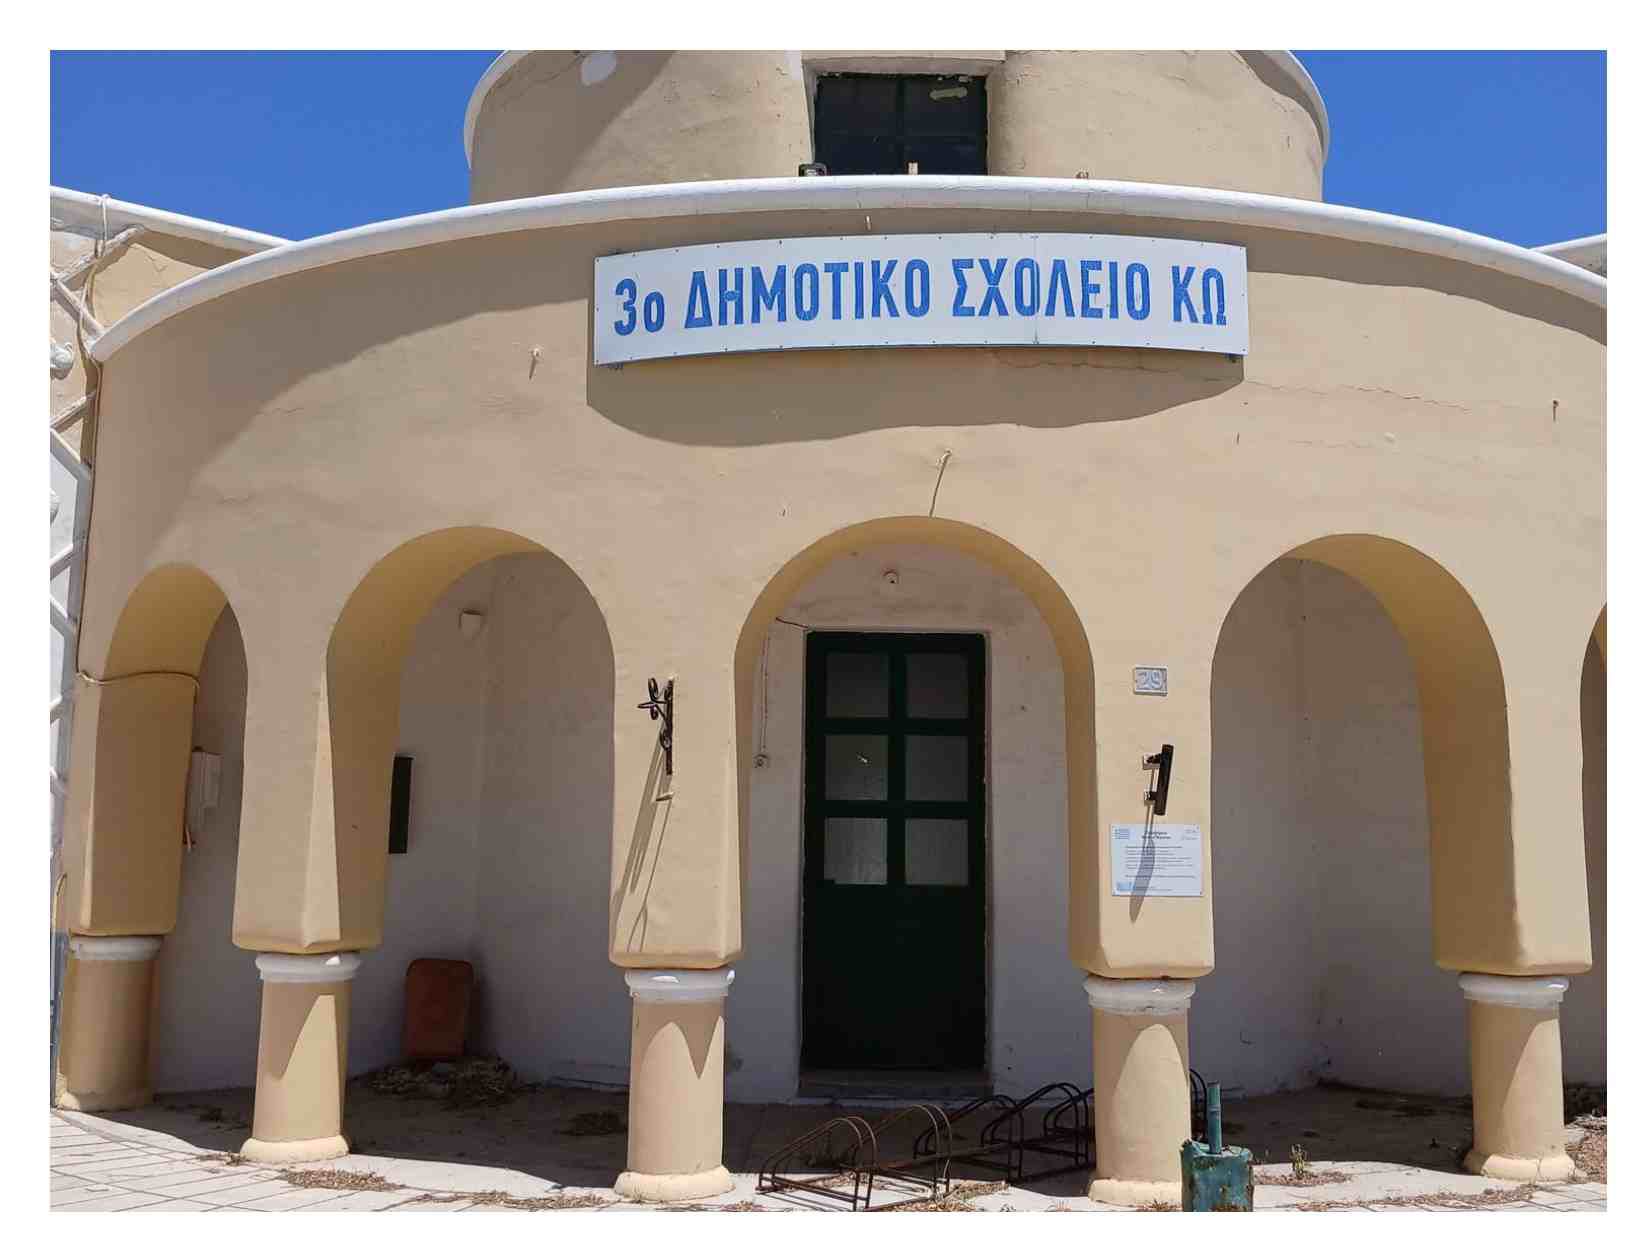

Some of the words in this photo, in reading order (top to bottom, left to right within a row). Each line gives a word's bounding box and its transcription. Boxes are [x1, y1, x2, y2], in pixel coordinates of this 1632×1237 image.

[682, 258, 931, 330] ΔΗΜΟΤΙΚΟ
[949, 256, 1152, 321] ΣΧΟΛΕΙΟ
[1171, 263, 1229, 327] ΚΩ
